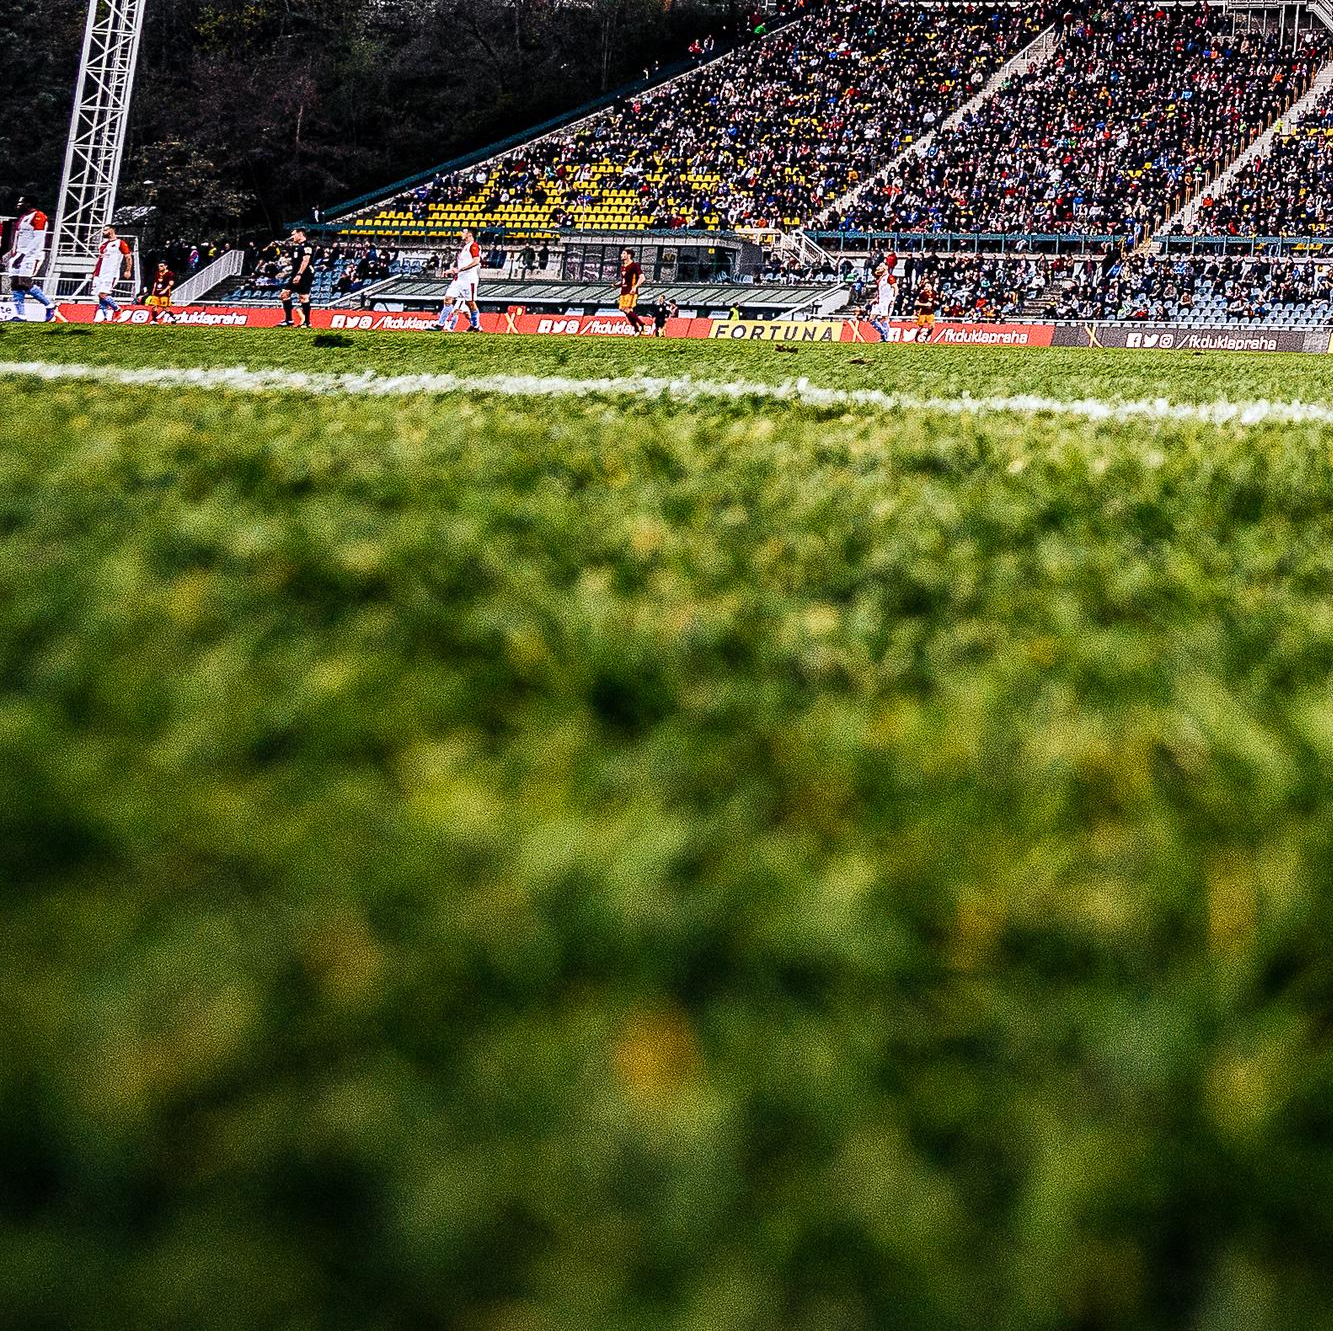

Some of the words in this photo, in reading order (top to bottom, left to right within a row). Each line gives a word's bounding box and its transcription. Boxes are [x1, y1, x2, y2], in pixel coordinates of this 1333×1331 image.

[715, 325, 833, 342] FORTUNA
[934, 324, 1028, 344] /fkduklapraha
[1176, 334, 1277, 352] /fkduklapraha
